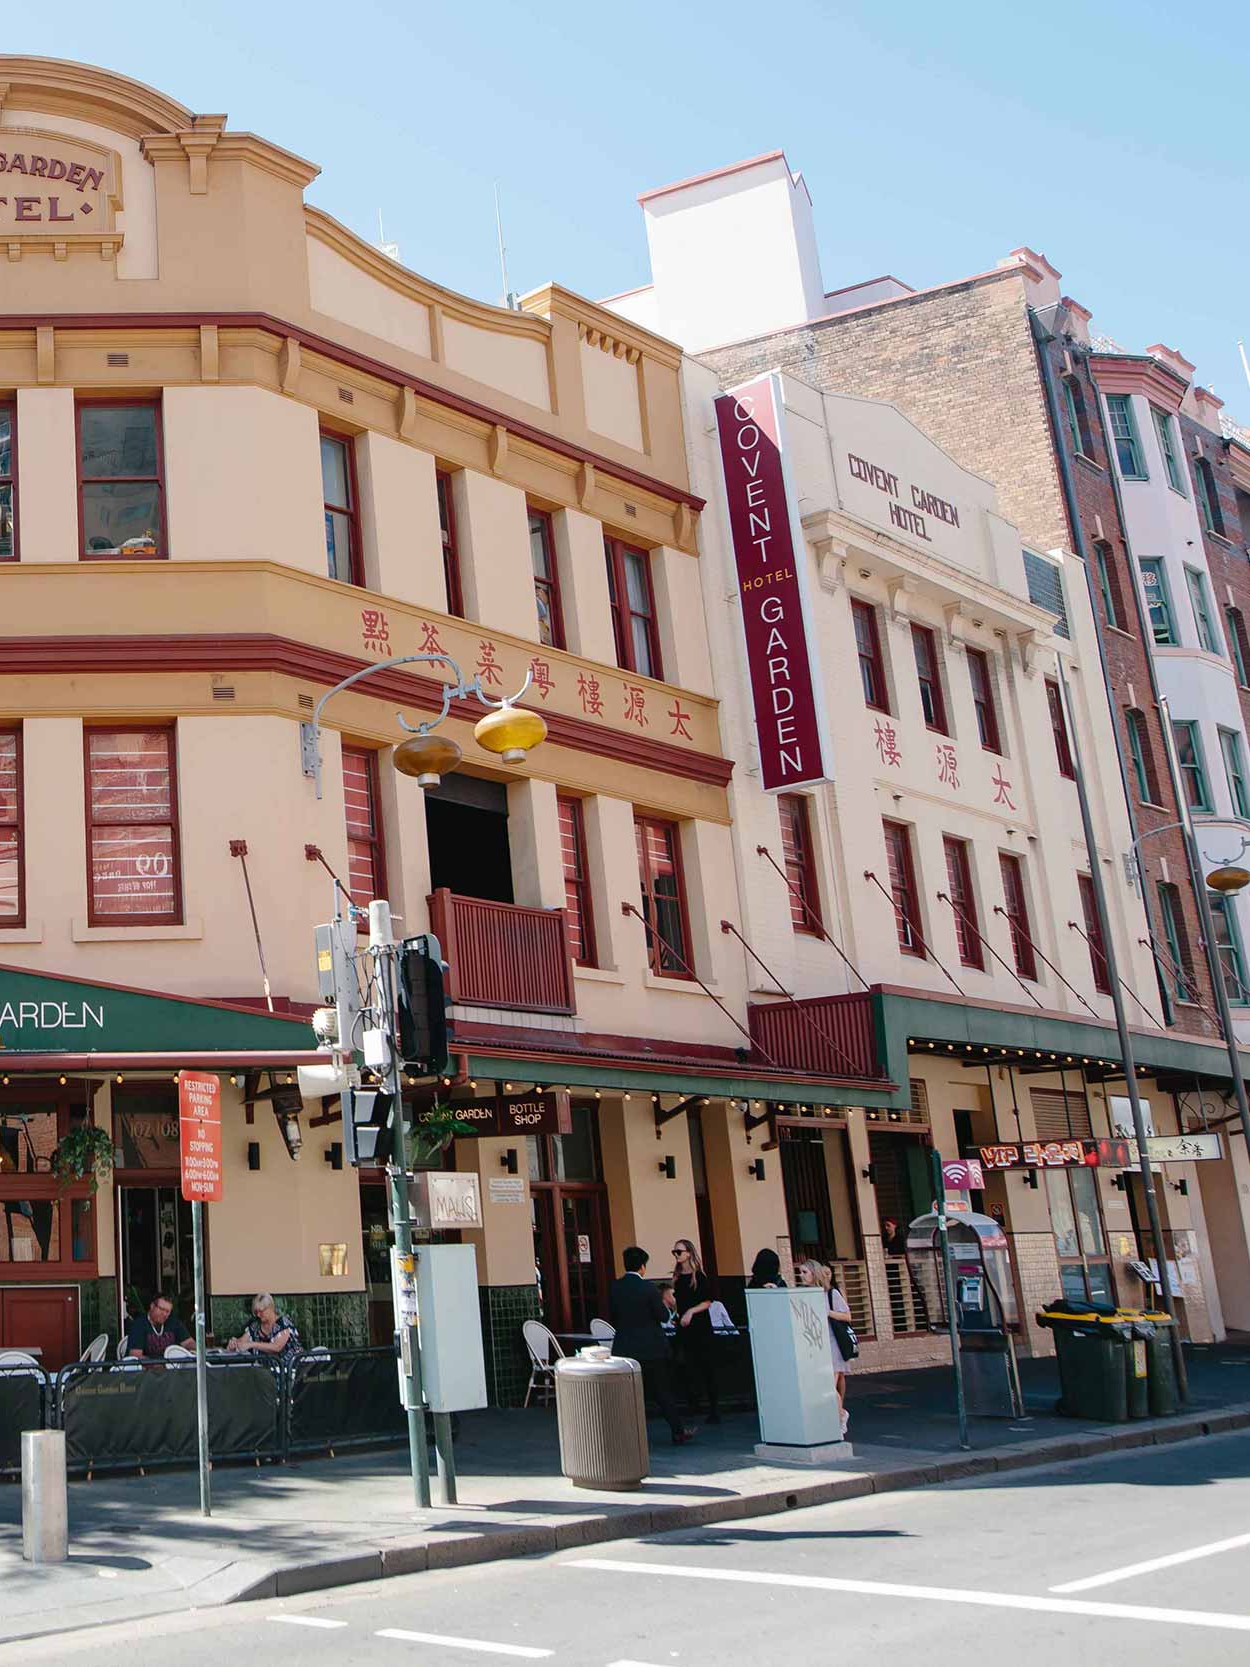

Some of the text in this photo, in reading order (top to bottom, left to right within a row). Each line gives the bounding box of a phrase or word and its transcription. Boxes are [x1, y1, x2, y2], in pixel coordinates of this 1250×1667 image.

[733, 396, 772, 563] COVENT
[847, 452, 899, 498] COVENT
[888, 501, 932, 542] HOTEL
[743, 570, 794, 592] HOTEL
[760, 596, 803, 777] GARDEN
[184, 1079, 217, 1094] RESTRICTED
[188, 1092, 213, 1105] PARKING
[193, 1105, 209, 1117] AREA
[455, 1107, 493, 1121] GARDEN
[509, 1102, 546, 1115] BOTTLE
[514, 1113, 542, 1126] SHOP
[189, 1141, 214, 1153] STOPPING
[979, 1145, 1019, 1168] VIP
